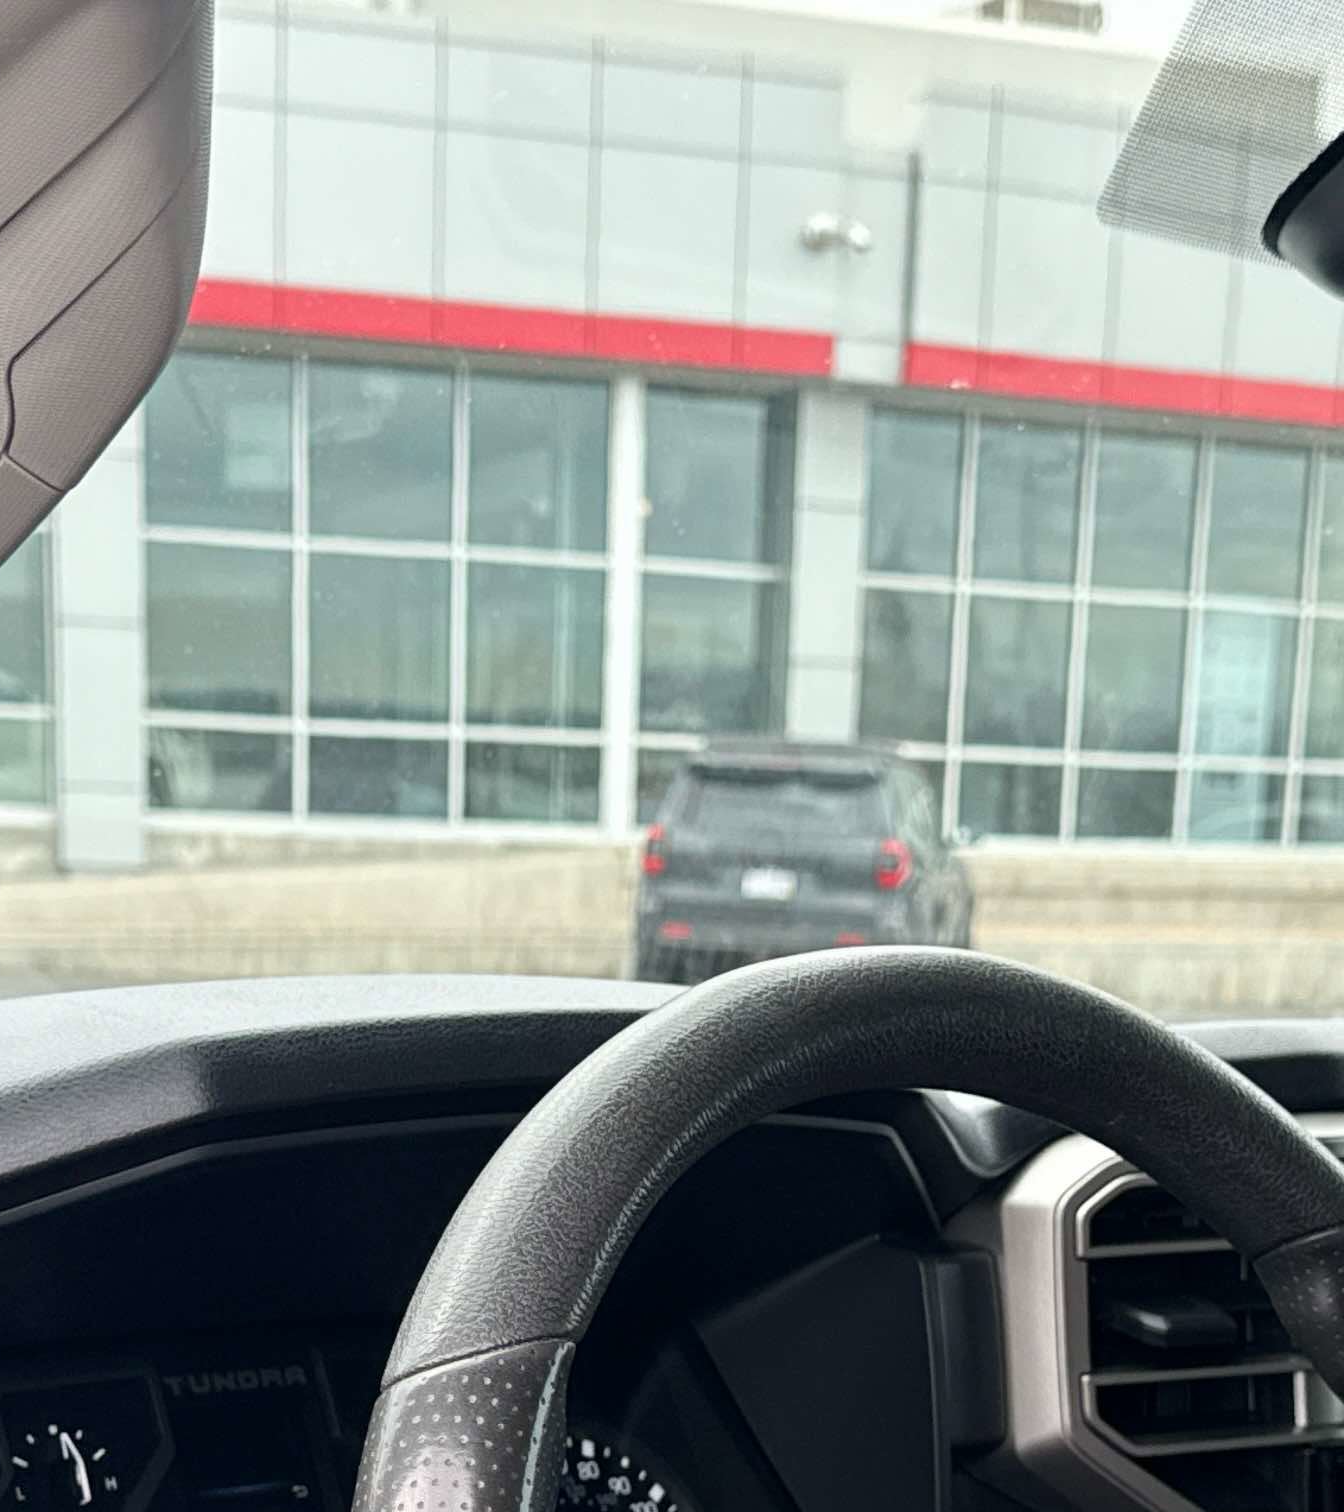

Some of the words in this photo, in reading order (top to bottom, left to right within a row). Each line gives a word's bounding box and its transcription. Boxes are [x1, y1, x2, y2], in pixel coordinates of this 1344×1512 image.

[163, 1366, 307, 1397] TUNDRA
[577, 1460, 600, 1481] 80
[106, 1476, 118, 1491] H
[608, 1475, 632, 1496] 90
